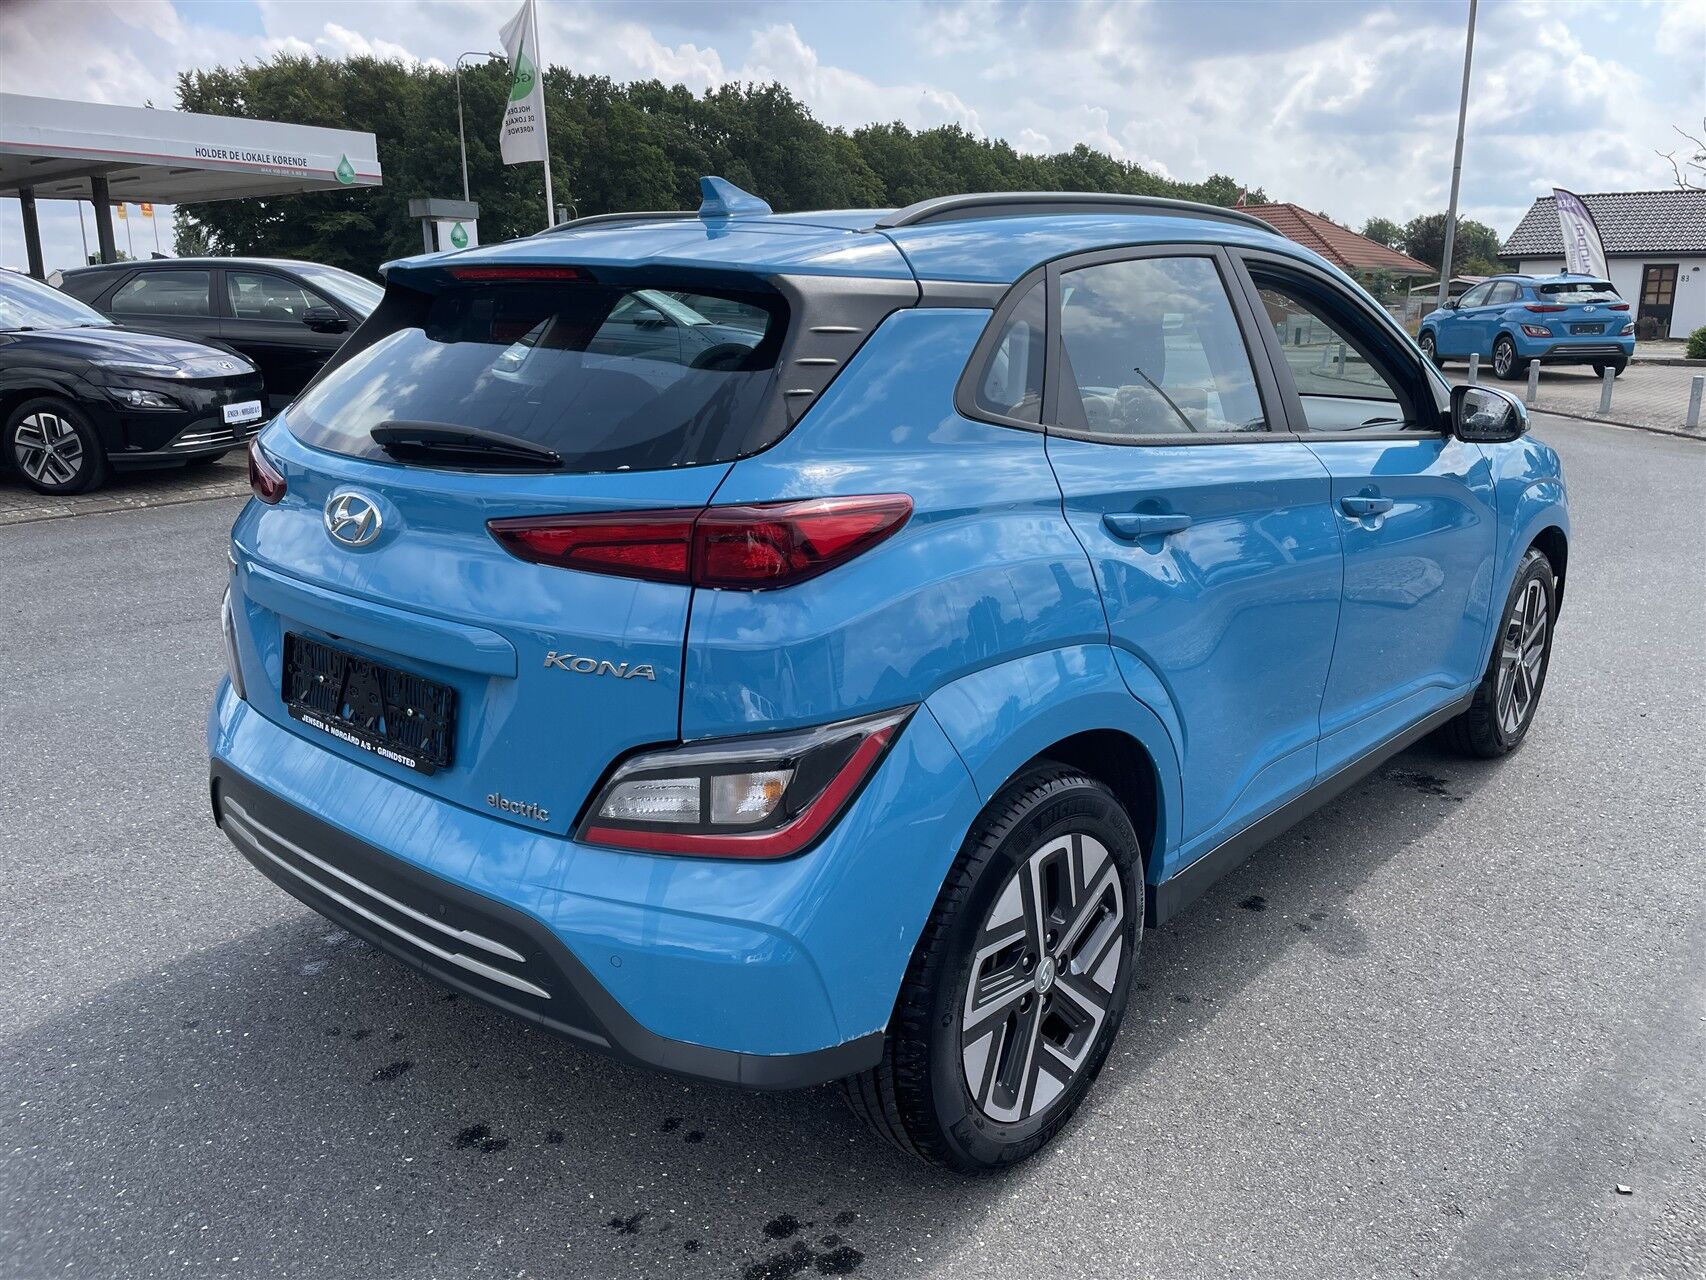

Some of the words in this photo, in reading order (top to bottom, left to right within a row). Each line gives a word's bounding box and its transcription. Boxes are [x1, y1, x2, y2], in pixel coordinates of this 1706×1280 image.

[195, 147, 228, 160] HOLDER
[229, 149, 240, 161] DE
[241, 152, 271, 164] LOKALE
[272, 154, 308, 167] KØRENDE
[1680, 274, 1690, 283] 83
[543, 651, 656, 681] KONA
[301, 714, 324, 729] JENSEN
[324, 724, 330, 733] &
[330, 727, 360, 746] NØRGÅRD
[360, 740, 371, 751] A/S
[377, 746, 416, 768] GRINDSTED
[486, 793, 550, 822] electric
